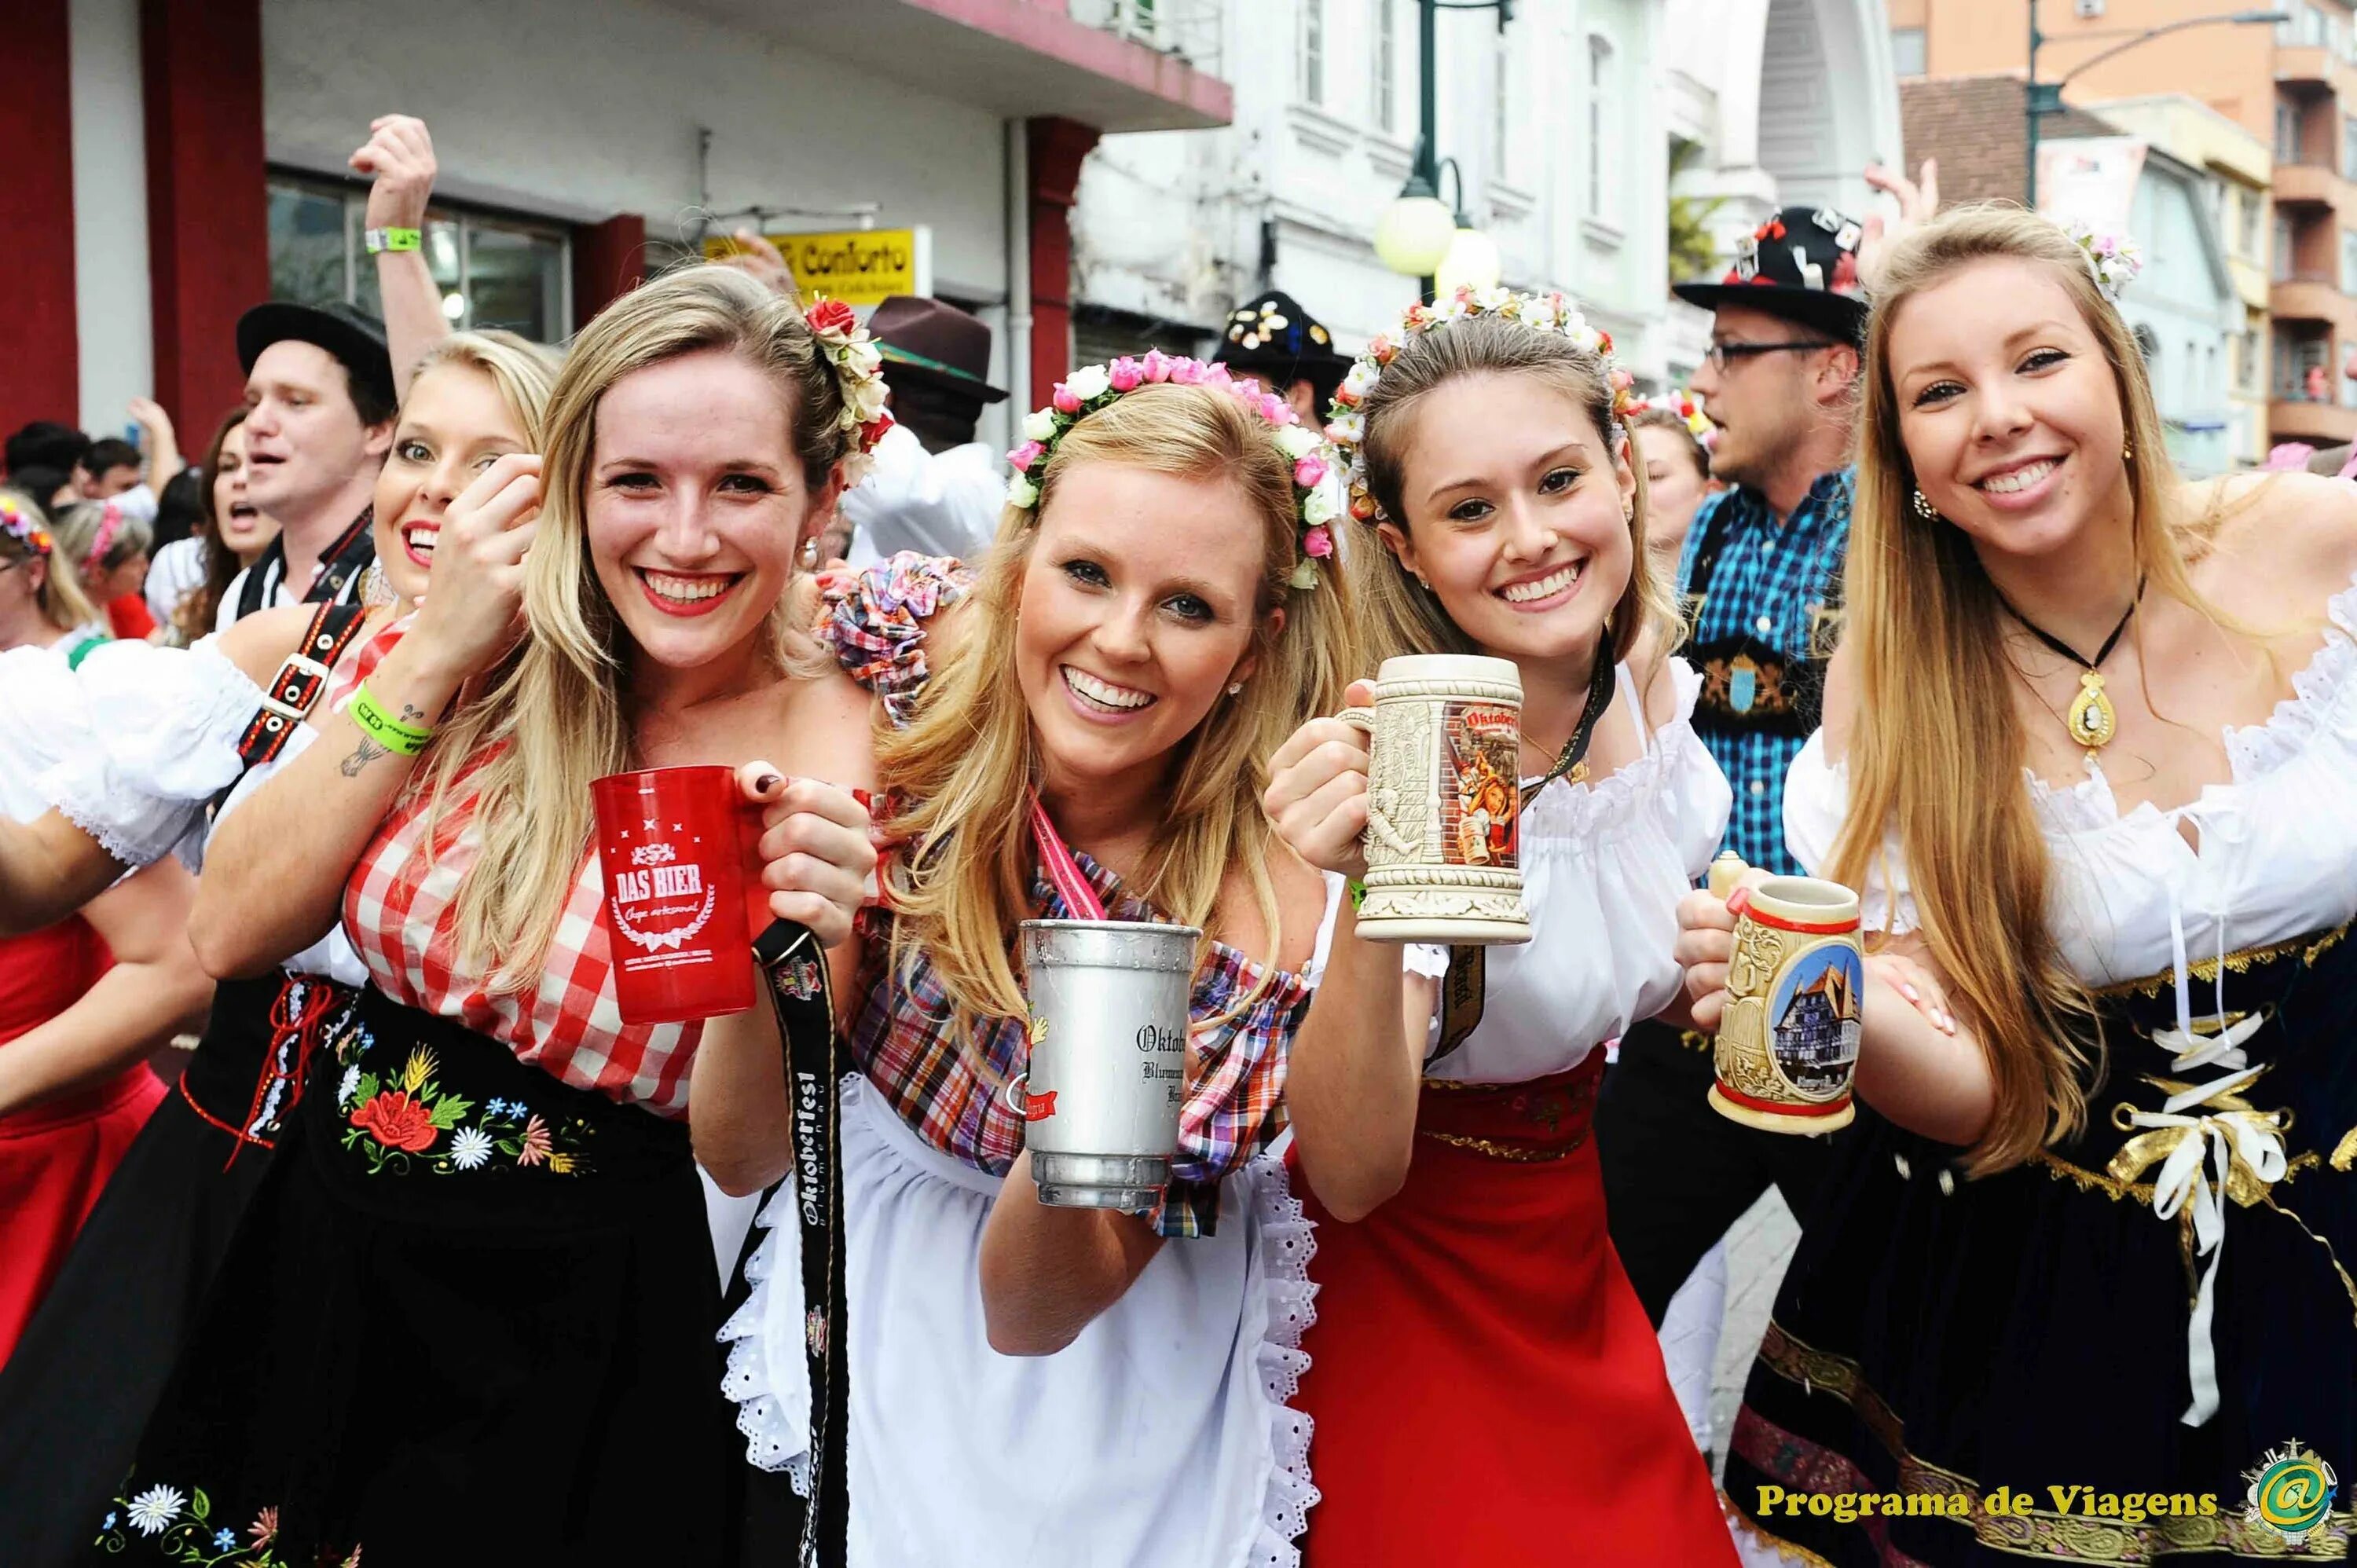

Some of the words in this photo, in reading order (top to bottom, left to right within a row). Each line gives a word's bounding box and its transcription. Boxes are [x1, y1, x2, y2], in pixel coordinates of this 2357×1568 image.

[803, 240, 907, 275] Conforto
[616, 870, 651, 903] DAS
[653, 864, 702, 898] BIER
[797, 1072, 819, 1226] Oktoberfest
